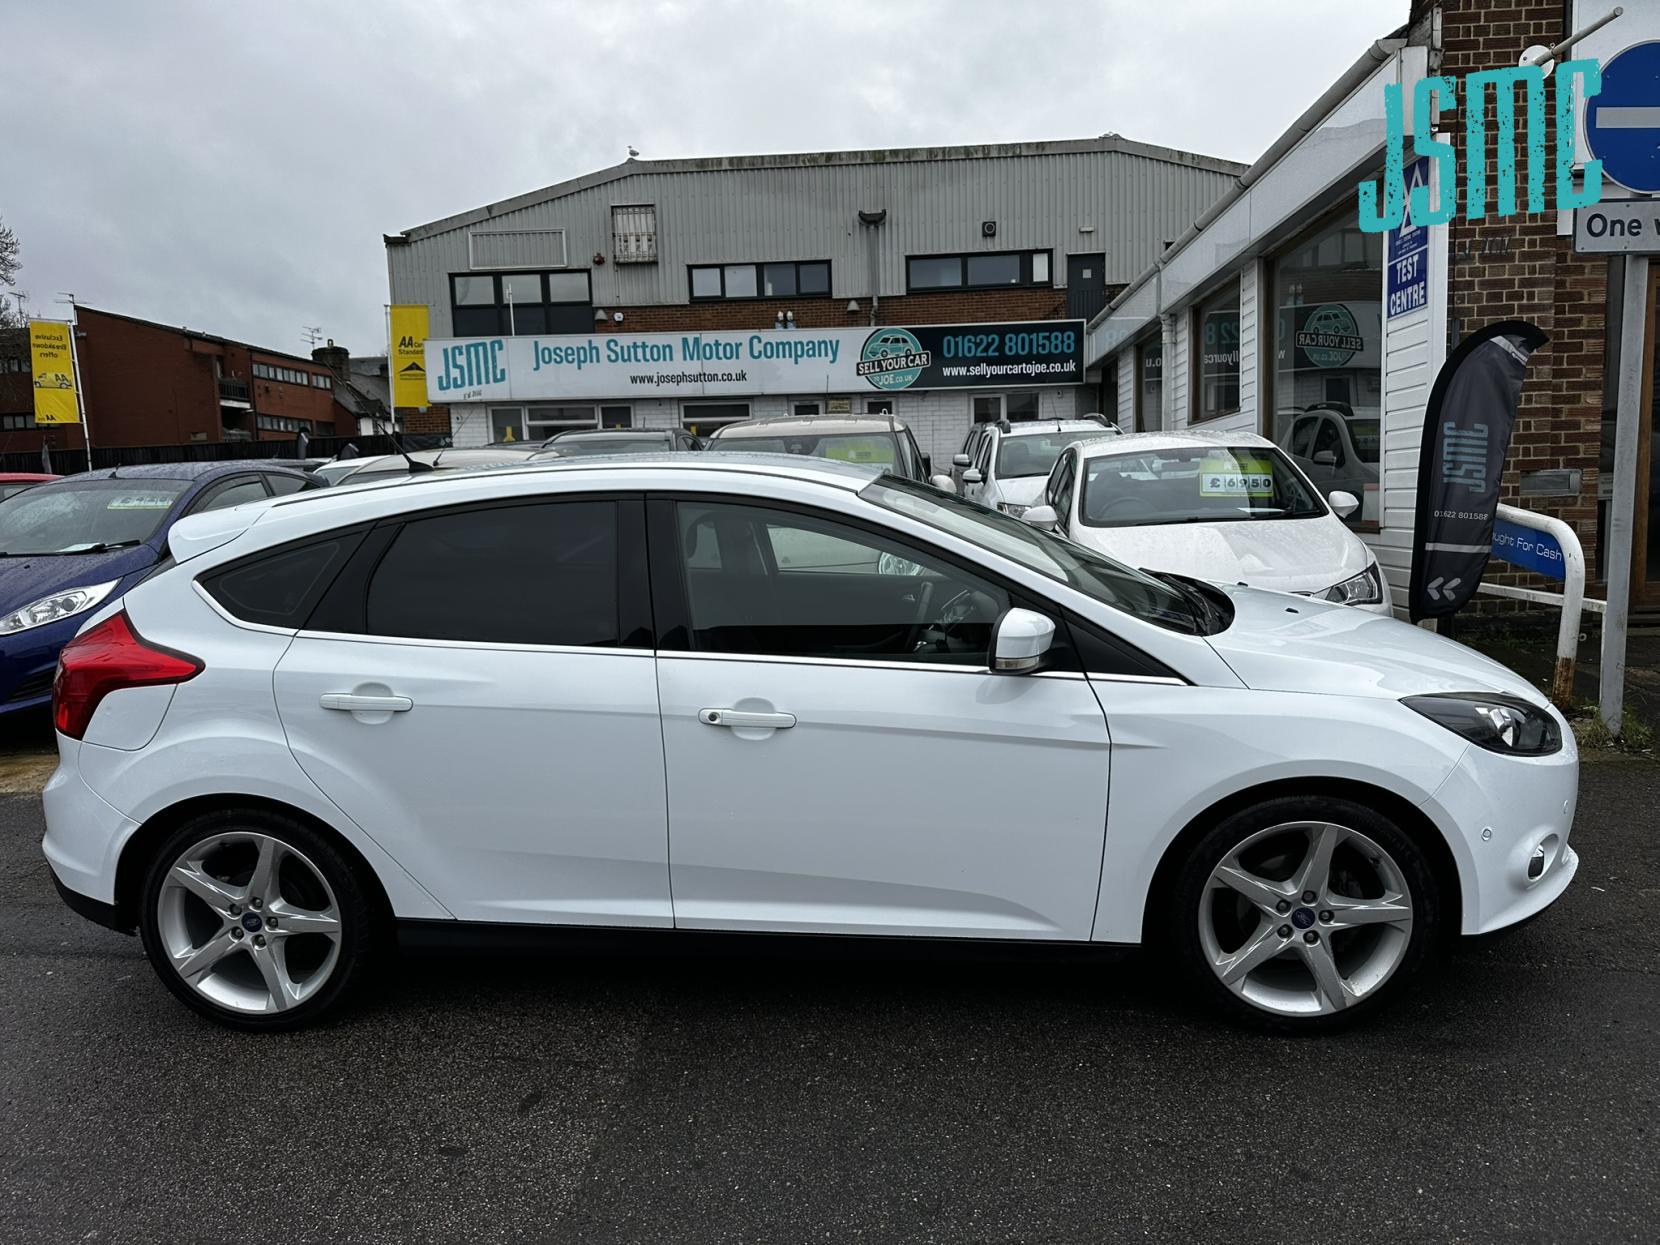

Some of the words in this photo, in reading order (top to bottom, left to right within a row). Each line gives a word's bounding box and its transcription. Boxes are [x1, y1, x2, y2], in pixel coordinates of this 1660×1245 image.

[1586, 213, 1642, 238] One
[1396, 254, 1419, 284] TEST
[1390, 281, 1425, 316] CENTRE
[398, 336, 414, 349] AA
[533, 339, 600, 371] Joseph
[606, 337, 674, 365] Sutton
[682, 336, 743, 361] Motor
[749, 335, 840, 365] Company
[943, 334, 1000, 358] 01622
[1004, 331, 1075, 356] 801588
[437, 339, 506, 391] JSMC
[858, 361, 880, 375] SELL
[881, 357, 907, 371] YOUR
[907, 354, 928, 367] CAR
[942, 359, 1077, 378] www.sellyourcartojoe.co.uk
[629, 369, 748, 387] www.josephsutton.co.uk
[1443, 421, 1488, 492] JSMC
[1434, 510, 1456, 519] 01622
[1458, 511, 1489, 520] 801588
[1517, 537, 1534, 552] For
[1536, 543, 1562, 561] Cash
